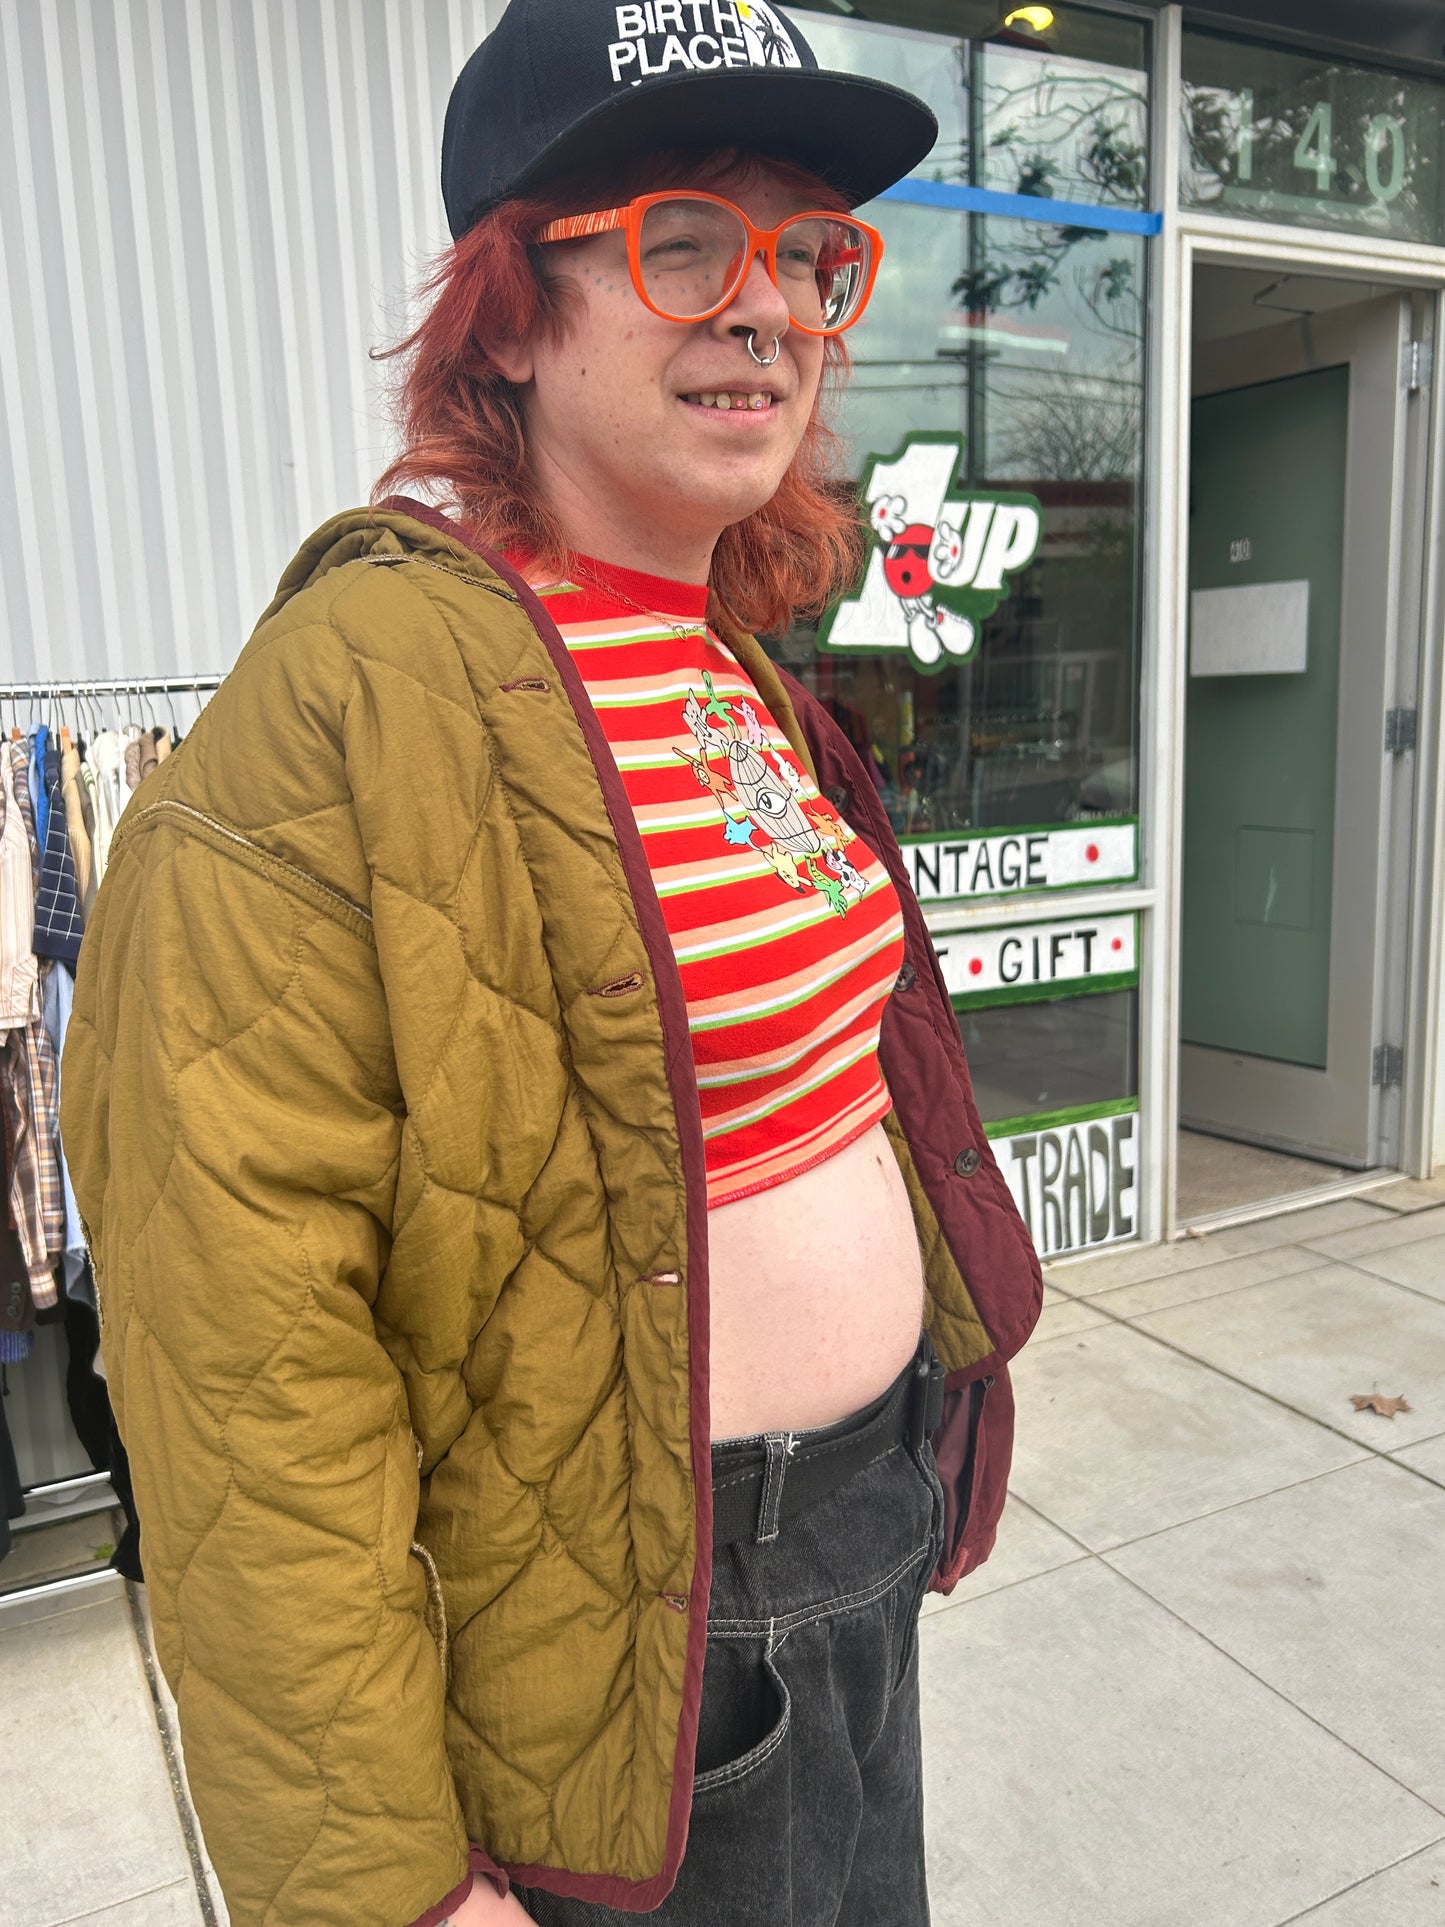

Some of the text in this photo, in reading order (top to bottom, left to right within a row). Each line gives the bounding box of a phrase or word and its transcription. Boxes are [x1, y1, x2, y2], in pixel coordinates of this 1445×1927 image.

[615, 0, 744, 39] BIRTH
[608, 35, 750, 82] PLACE
[1224, 88, 1406, 201] 140
[827, 444, 1039, 647] 1UP
[899, 834, 1049, 896] NTAGE
[998, 927, 1098, 984] GIFT
[1010, 1114, 1133, 1253] TRADE
